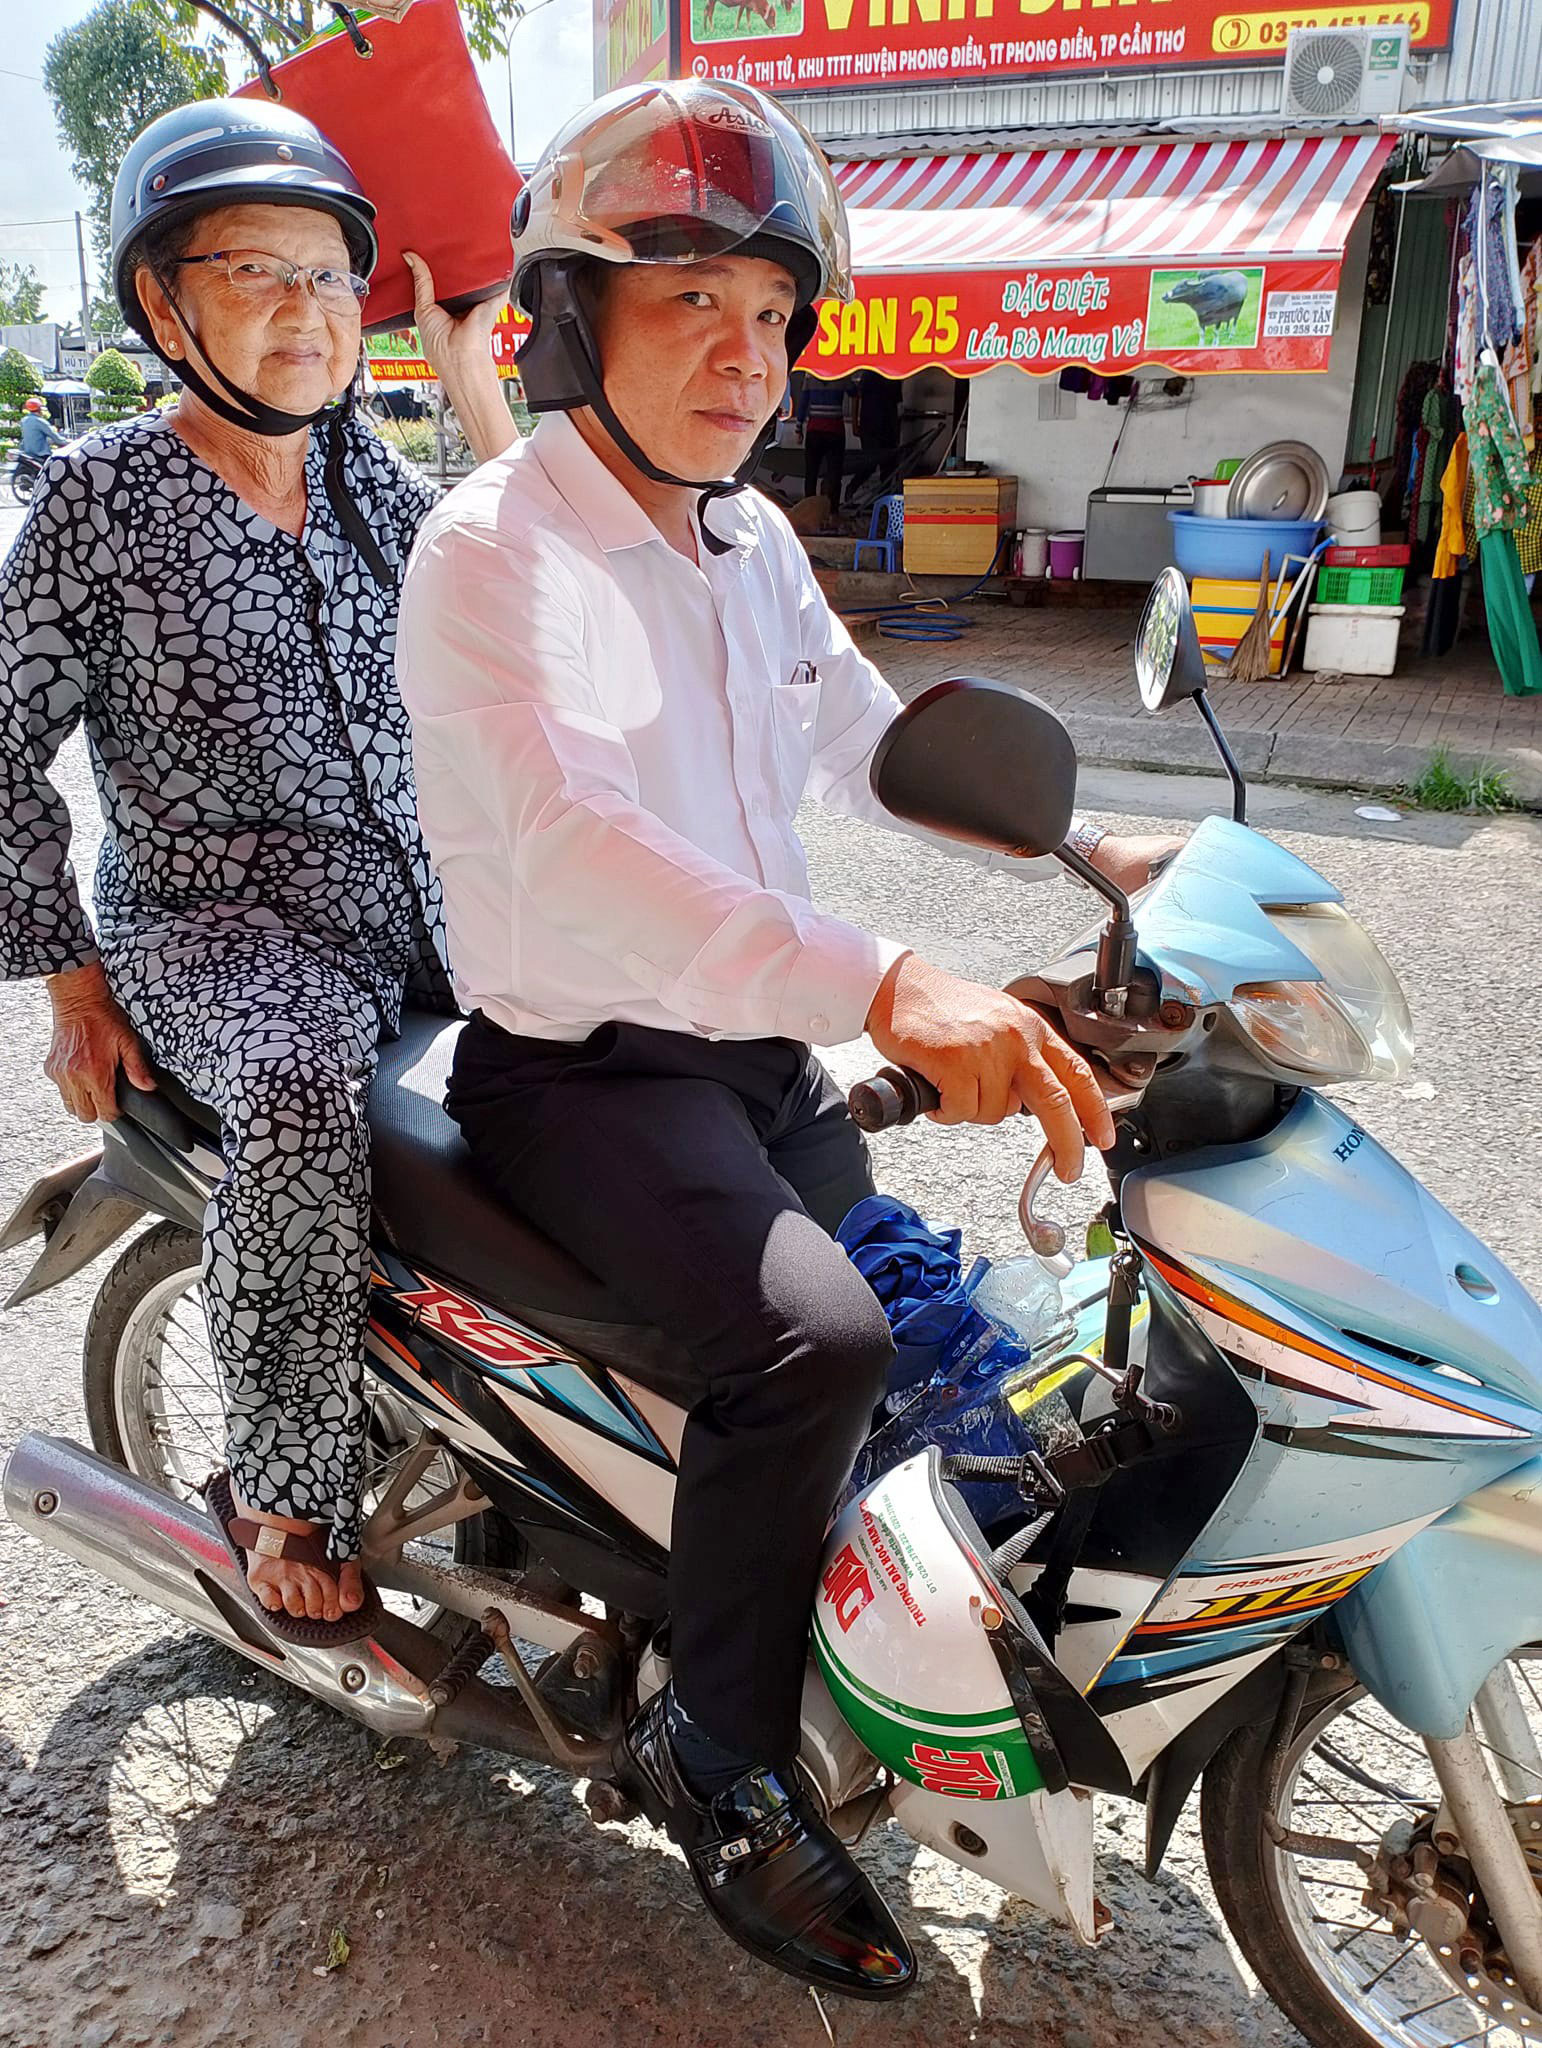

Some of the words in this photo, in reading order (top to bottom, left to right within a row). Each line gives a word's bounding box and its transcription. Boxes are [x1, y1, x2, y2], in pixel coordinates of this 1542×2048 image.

[712, 64, 734, 80] 132
[736, 55, 753, 82] ẤP
[755, 60, 775, 86] THỊ
[798, 57, 824, 80] KHU
[826, 54, 853, 77] TTTT
[855, 46, 897, 78] HUYỆN
[900, 46, 949, 71] PHONG
[951, 34, 986, 70] ĐIỀN,
[989, 42, 1005, 65] TT
[1006, 38, 1057, 64] PHONG
[1060, 25, 1097, 62] ĐIỀN,
[1100, 34, 1117, 57] TP
[1119, 21, 1152, 55] CẦN
[1155, 25, 1186, 54] THƠ
[1002, 273, 1053, 318] ĐẶC
[1052, 271, 1110, 316] BIỆT:
[1278, 307, 1311, 324] PHƯỚC
[909, 295, 960, 355] 25
[966, 322, 1009, 360] Lẩu
[1010, 325, 1041, 359] Bò
[1041, 326, 1109, 364] Mang
[1112, 318, 1144, 358] Về
[1267, 325, 1290, 335] 0918
[1292, 324, 1311, 335] 258
[1313, 324, 1331, 335] 447
[867, 1524, 881, 1546] NAM
[1215, 1568, 1314, 1592] FASHION
[1316, 1546, 1393, 1574] SPORT
[1193, 1566, 1375, 1620] 110
